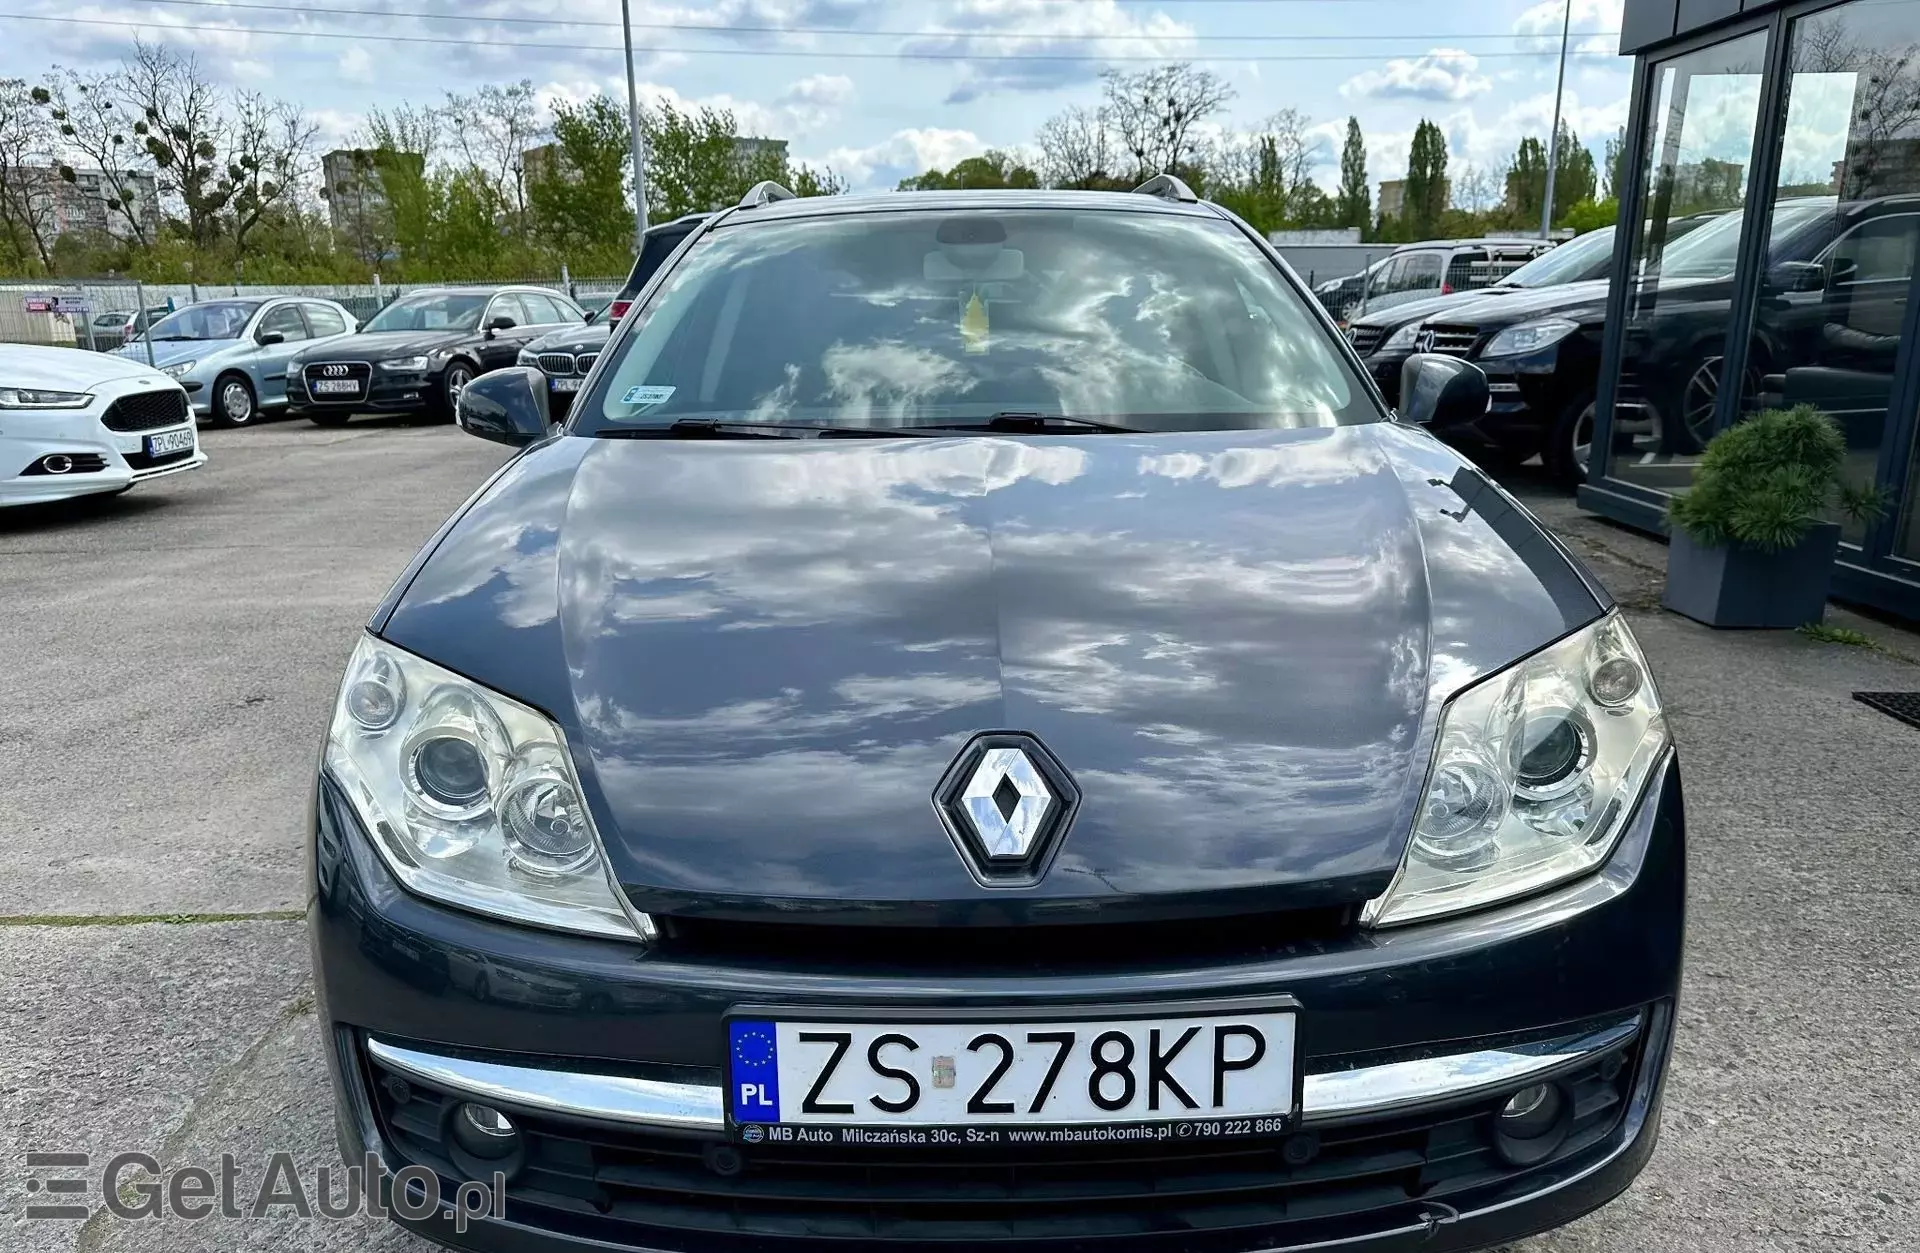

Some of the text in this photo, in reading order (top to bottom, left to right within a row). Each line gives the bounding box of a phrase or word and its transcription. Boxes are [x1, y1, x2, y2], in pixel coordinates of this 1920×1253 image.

[798, 1024, 1267, 1115] ZS 278KP
[740, 1084, 773, 1107] PL
[768, 1126, 793, 1141] MB
[797, 1127, 834, 1142] Auto
[842, 1128, 926, 1144] Milczańska
[930, 1129, 962, 1145] 30c,
[966, 1128, 1000, 1143] Sz-n
[1008, 1123, 1172, 1143] www.mbautokomis.pl
[1193, 1122, 1221, 1137] 790
[1224, 1120, 1251, 1135] 222
[1255, 1118, 1282, 1133] 866
